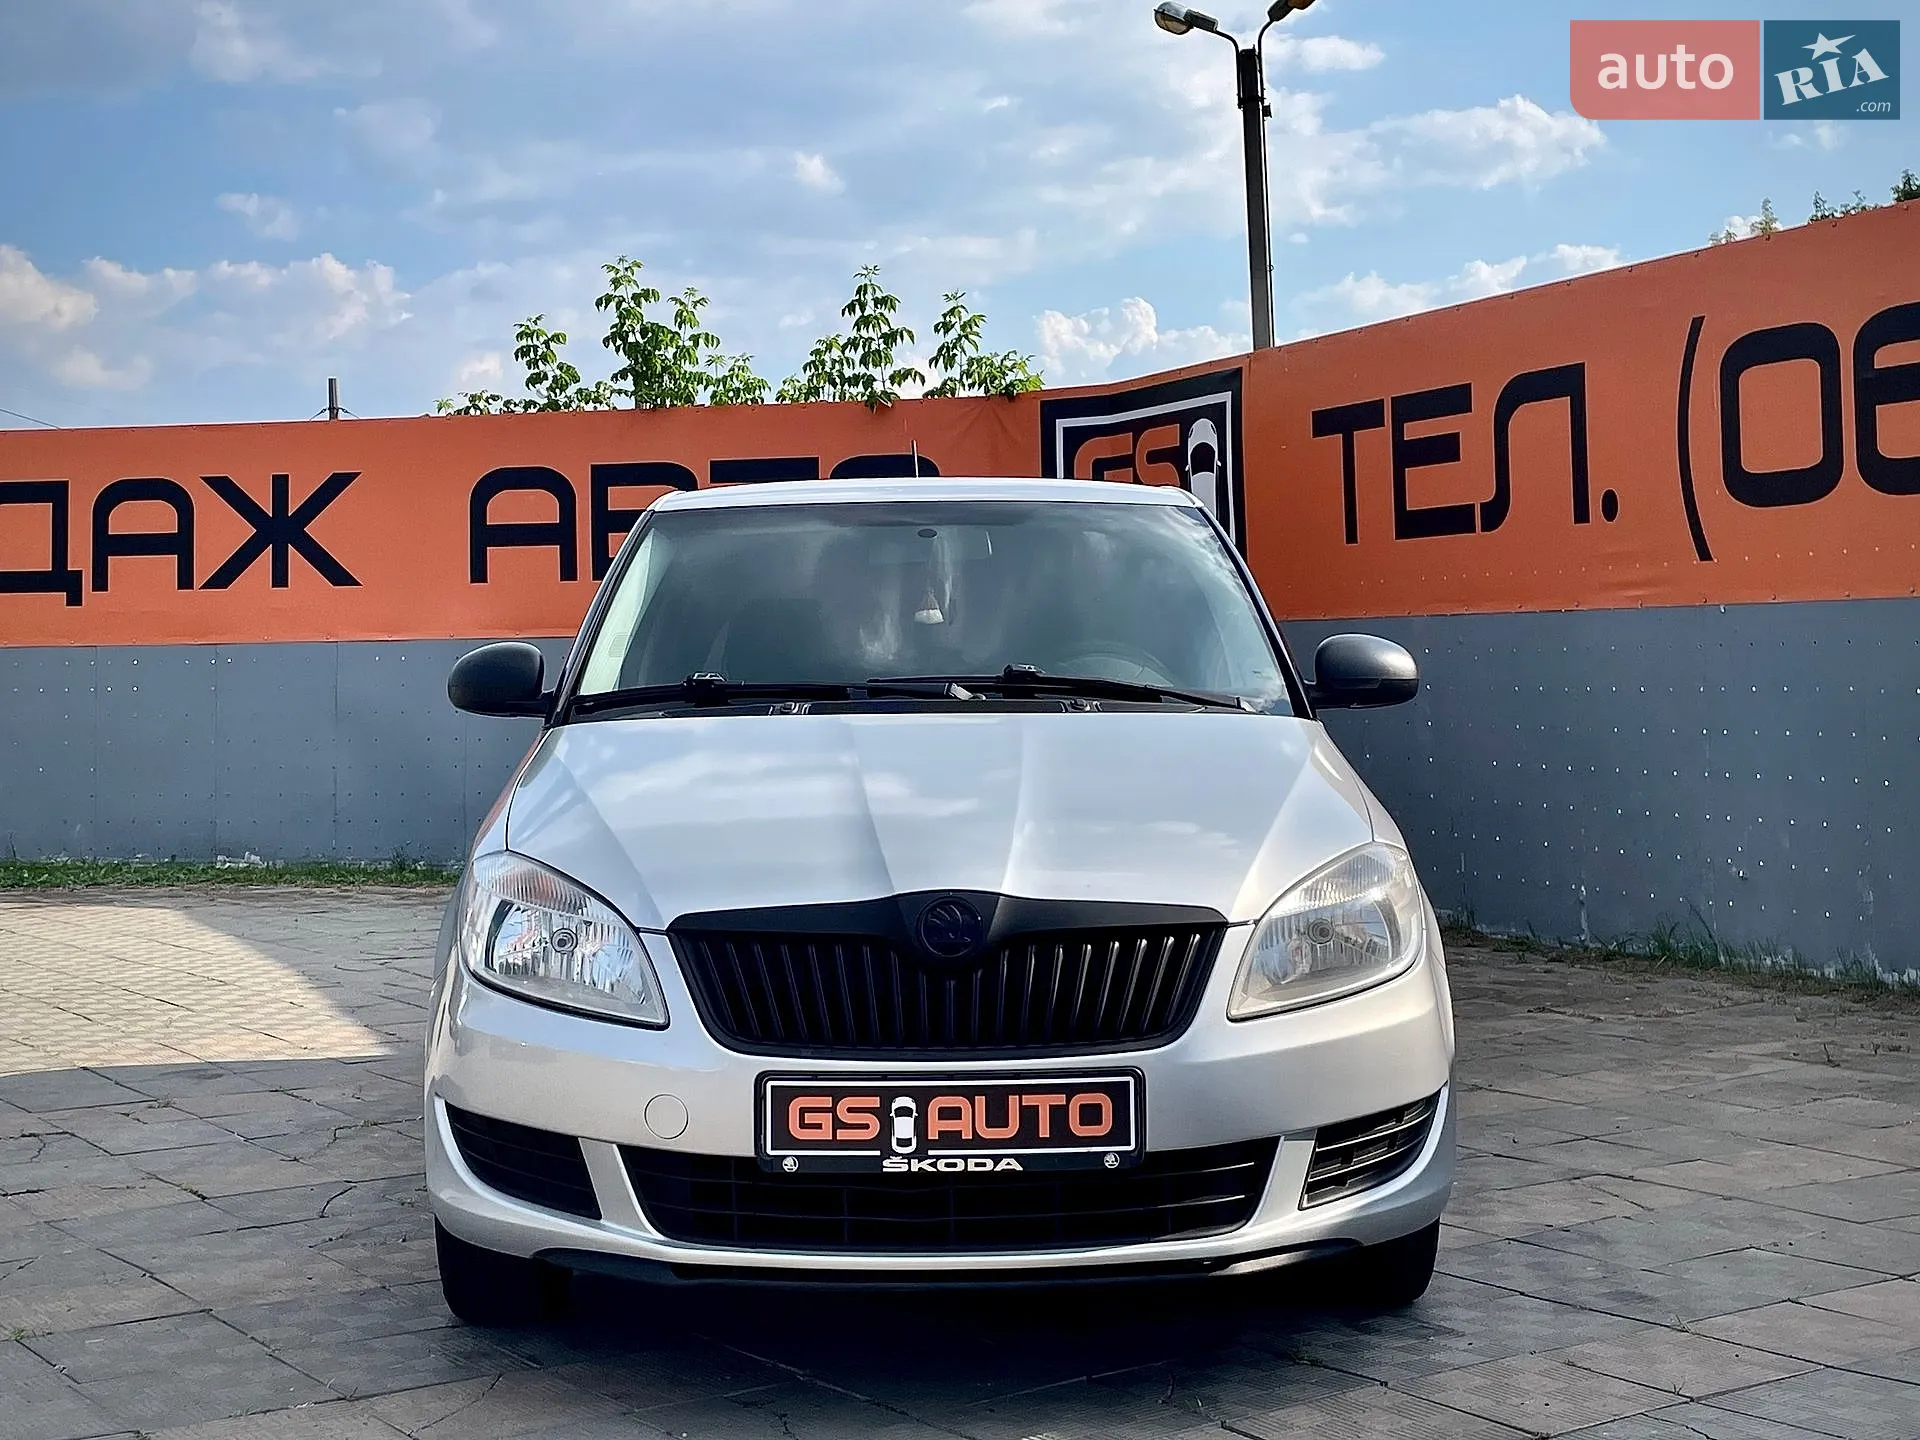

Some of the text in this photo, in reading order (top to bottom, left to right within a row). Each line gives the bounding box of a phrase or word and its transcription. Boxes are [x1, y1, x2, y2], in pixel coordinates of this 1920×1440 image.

[1311, 361, 1620, 546] ТЕЛ.
[788, 1092, 1113, 1141] GS AUTO
[882, 1155, 1024, 1173] ŠKODA
